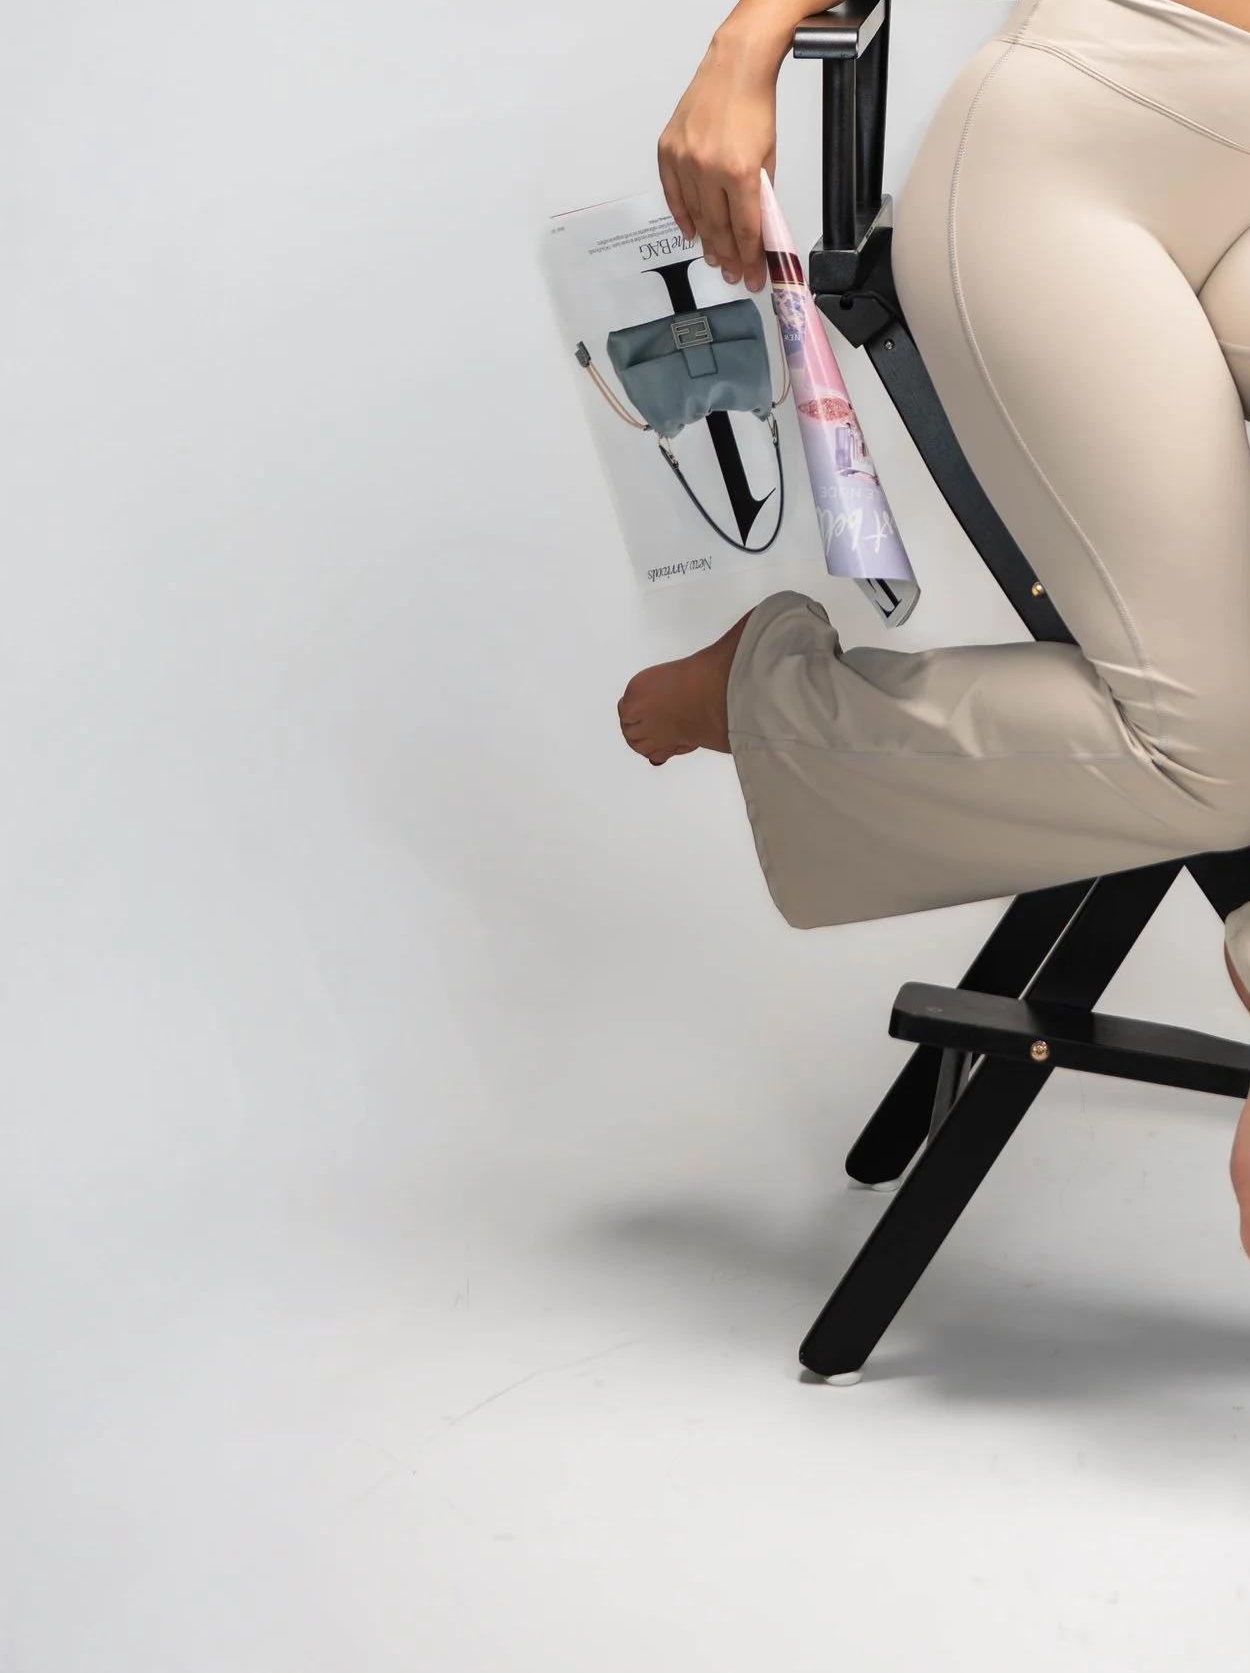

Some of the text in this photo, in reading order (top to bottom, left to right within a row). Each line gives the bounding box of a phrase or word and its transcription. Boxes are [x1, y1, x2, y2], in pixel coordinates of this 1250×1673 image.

[640, 238, 672, 260] BAG
[820, 486, 861, 499] NUDE
[647, 556, 712, 583] New Arrivals
